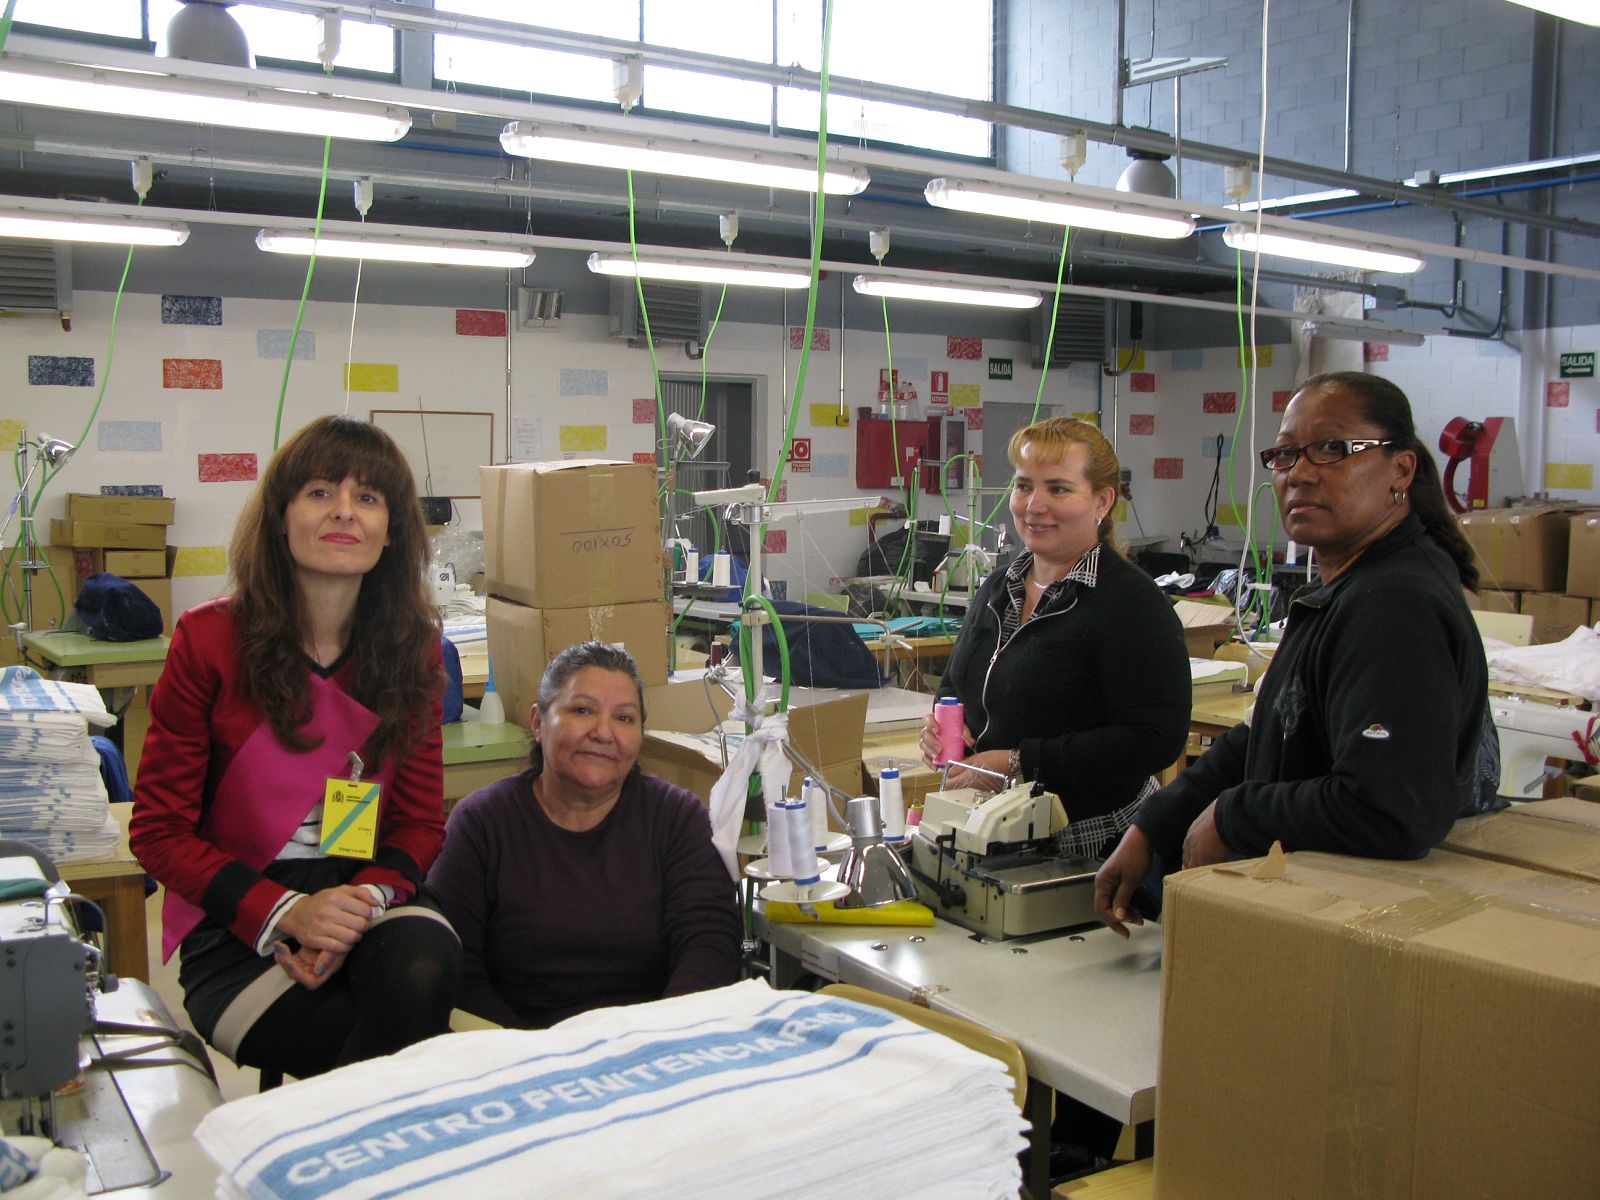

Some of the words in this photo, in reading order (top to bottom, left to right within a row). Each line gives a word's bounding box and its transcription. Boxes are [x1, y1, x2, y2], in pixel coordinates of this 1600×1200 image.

[1561, 356, 1593, 367] SALIDA
[990, 363, 1012, 375] SALIDA
[286, 1100, 516, 1185] CENTRO
[520, 1012, 857, 1110] PENITENCIARIO
